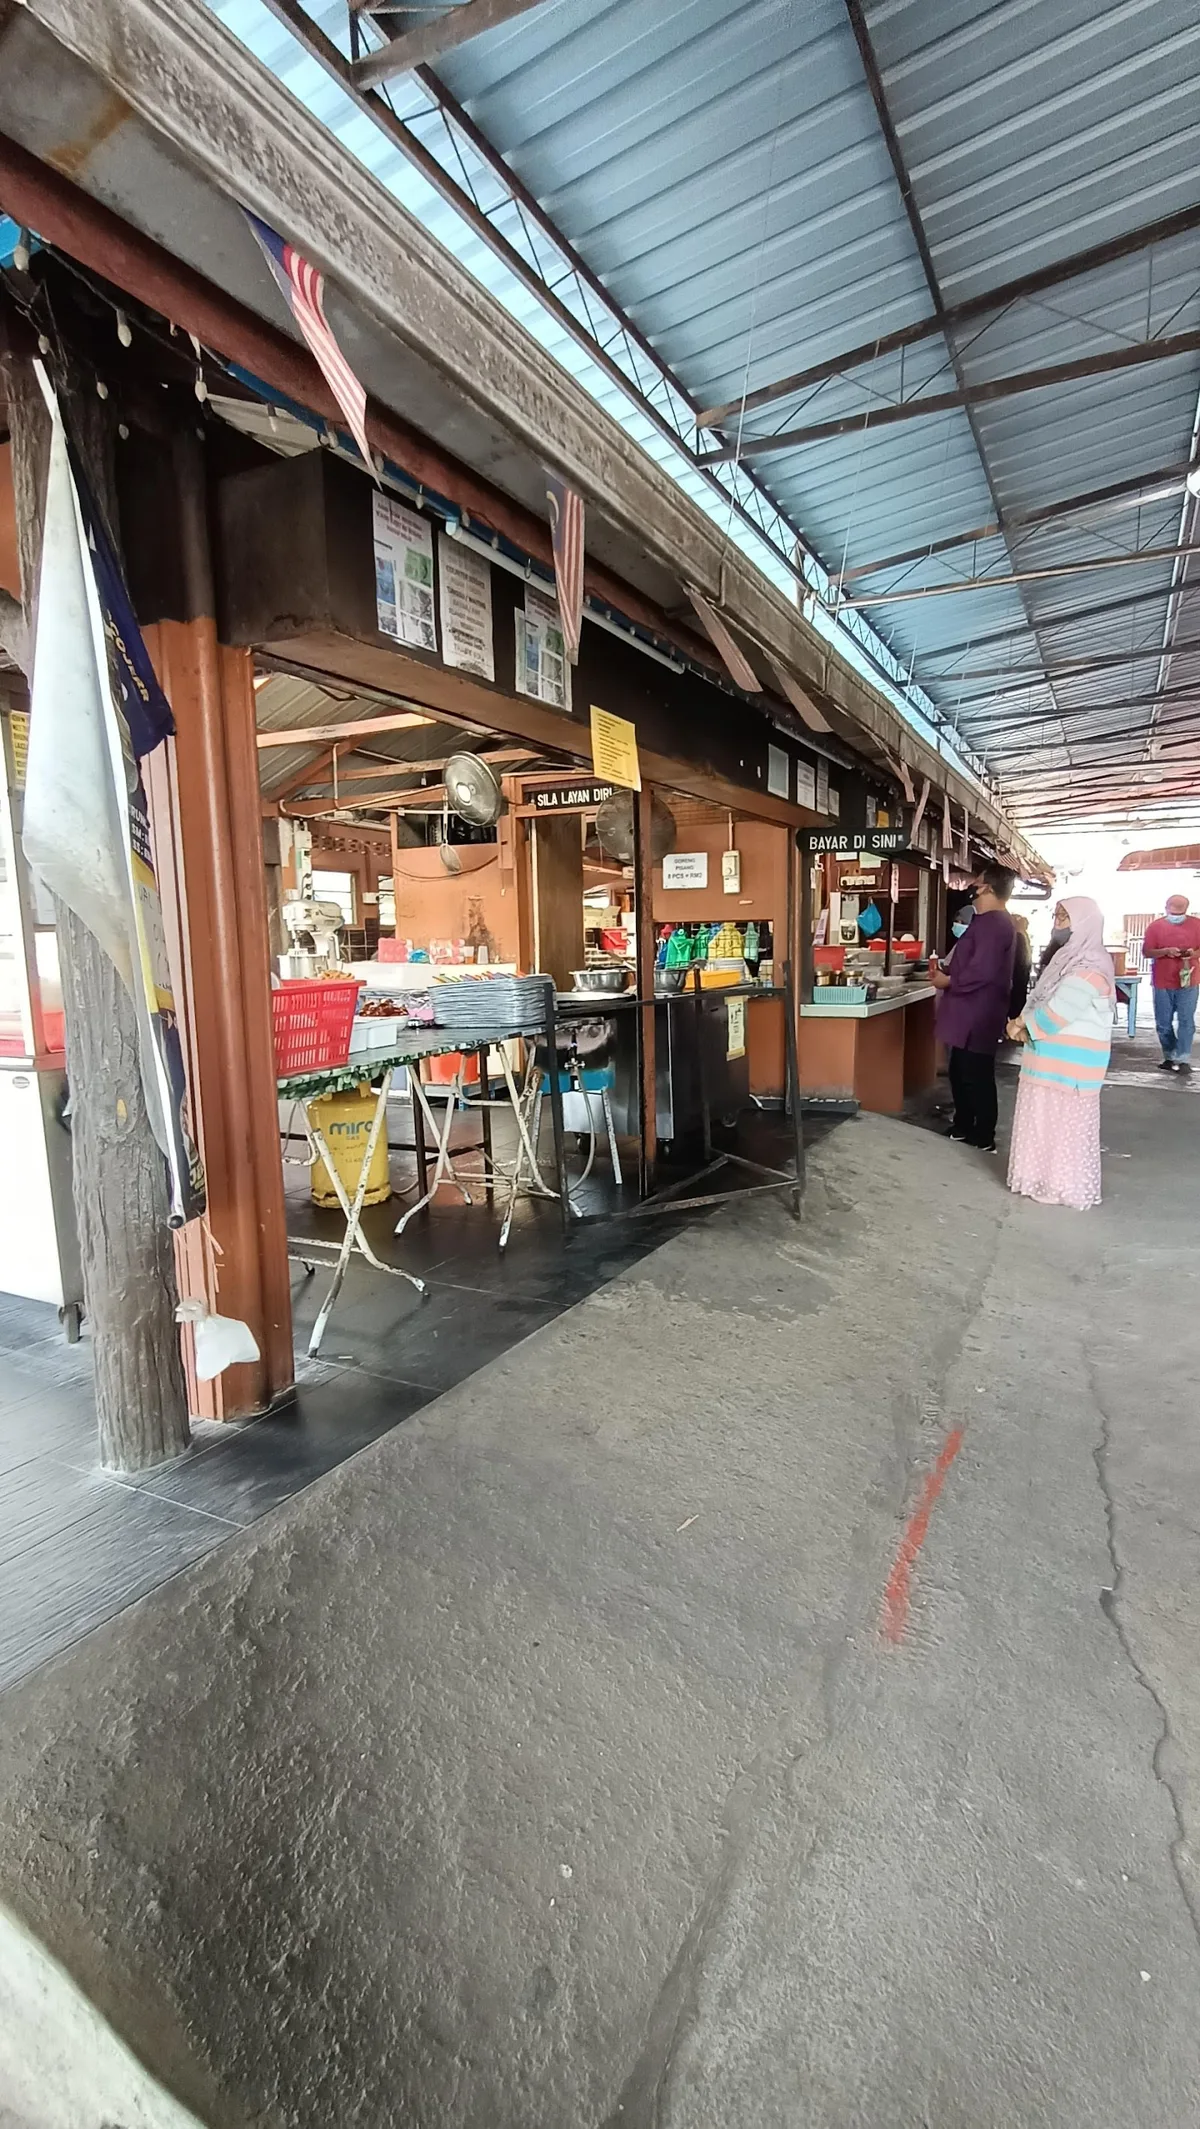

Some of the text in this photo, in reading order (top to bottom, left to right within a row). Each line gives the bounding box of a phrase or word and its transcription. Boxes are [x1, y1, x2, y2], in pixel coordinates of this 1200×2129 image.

[537, 793, 558, 807] SILA
[561, 789, 590, 804] LAYAN
[809, 833, 897, 850] BAYAR DI SINI
